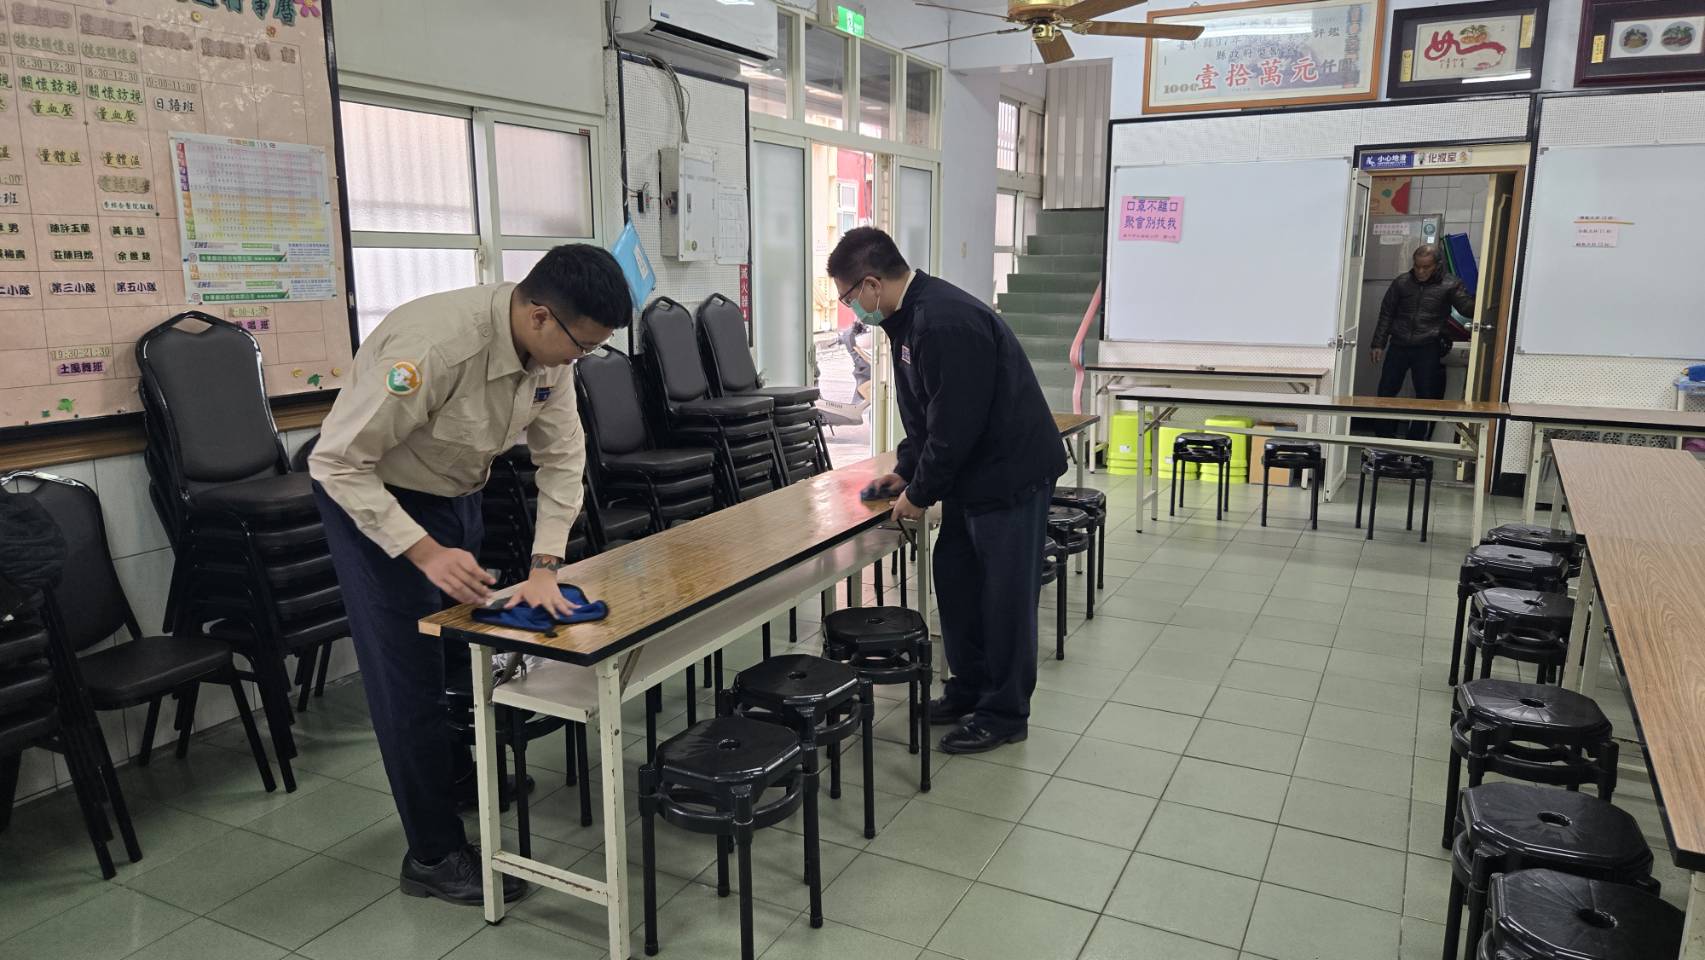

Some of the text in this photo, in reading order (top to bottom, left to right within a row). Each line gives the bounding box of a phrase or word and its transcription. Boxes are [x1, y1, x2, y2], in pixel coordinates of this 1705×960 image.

[1195, 57, 1319, 92] 壹拾萬元
[32, 100, 73, 116] 量血壓
[156, 98, 194, 112] 日語班
[100, 106, 136, 122] 量血壓
[1377, 154, 1407, 163] 小心地滑
[1126, 199, 1179, 213] 口罩不離口
[1124, 215, 1177, 230] 聚會別找我
[52, 282, 96, 293] 第三小隊
[117, 282, 157, 292] 第五小隊
